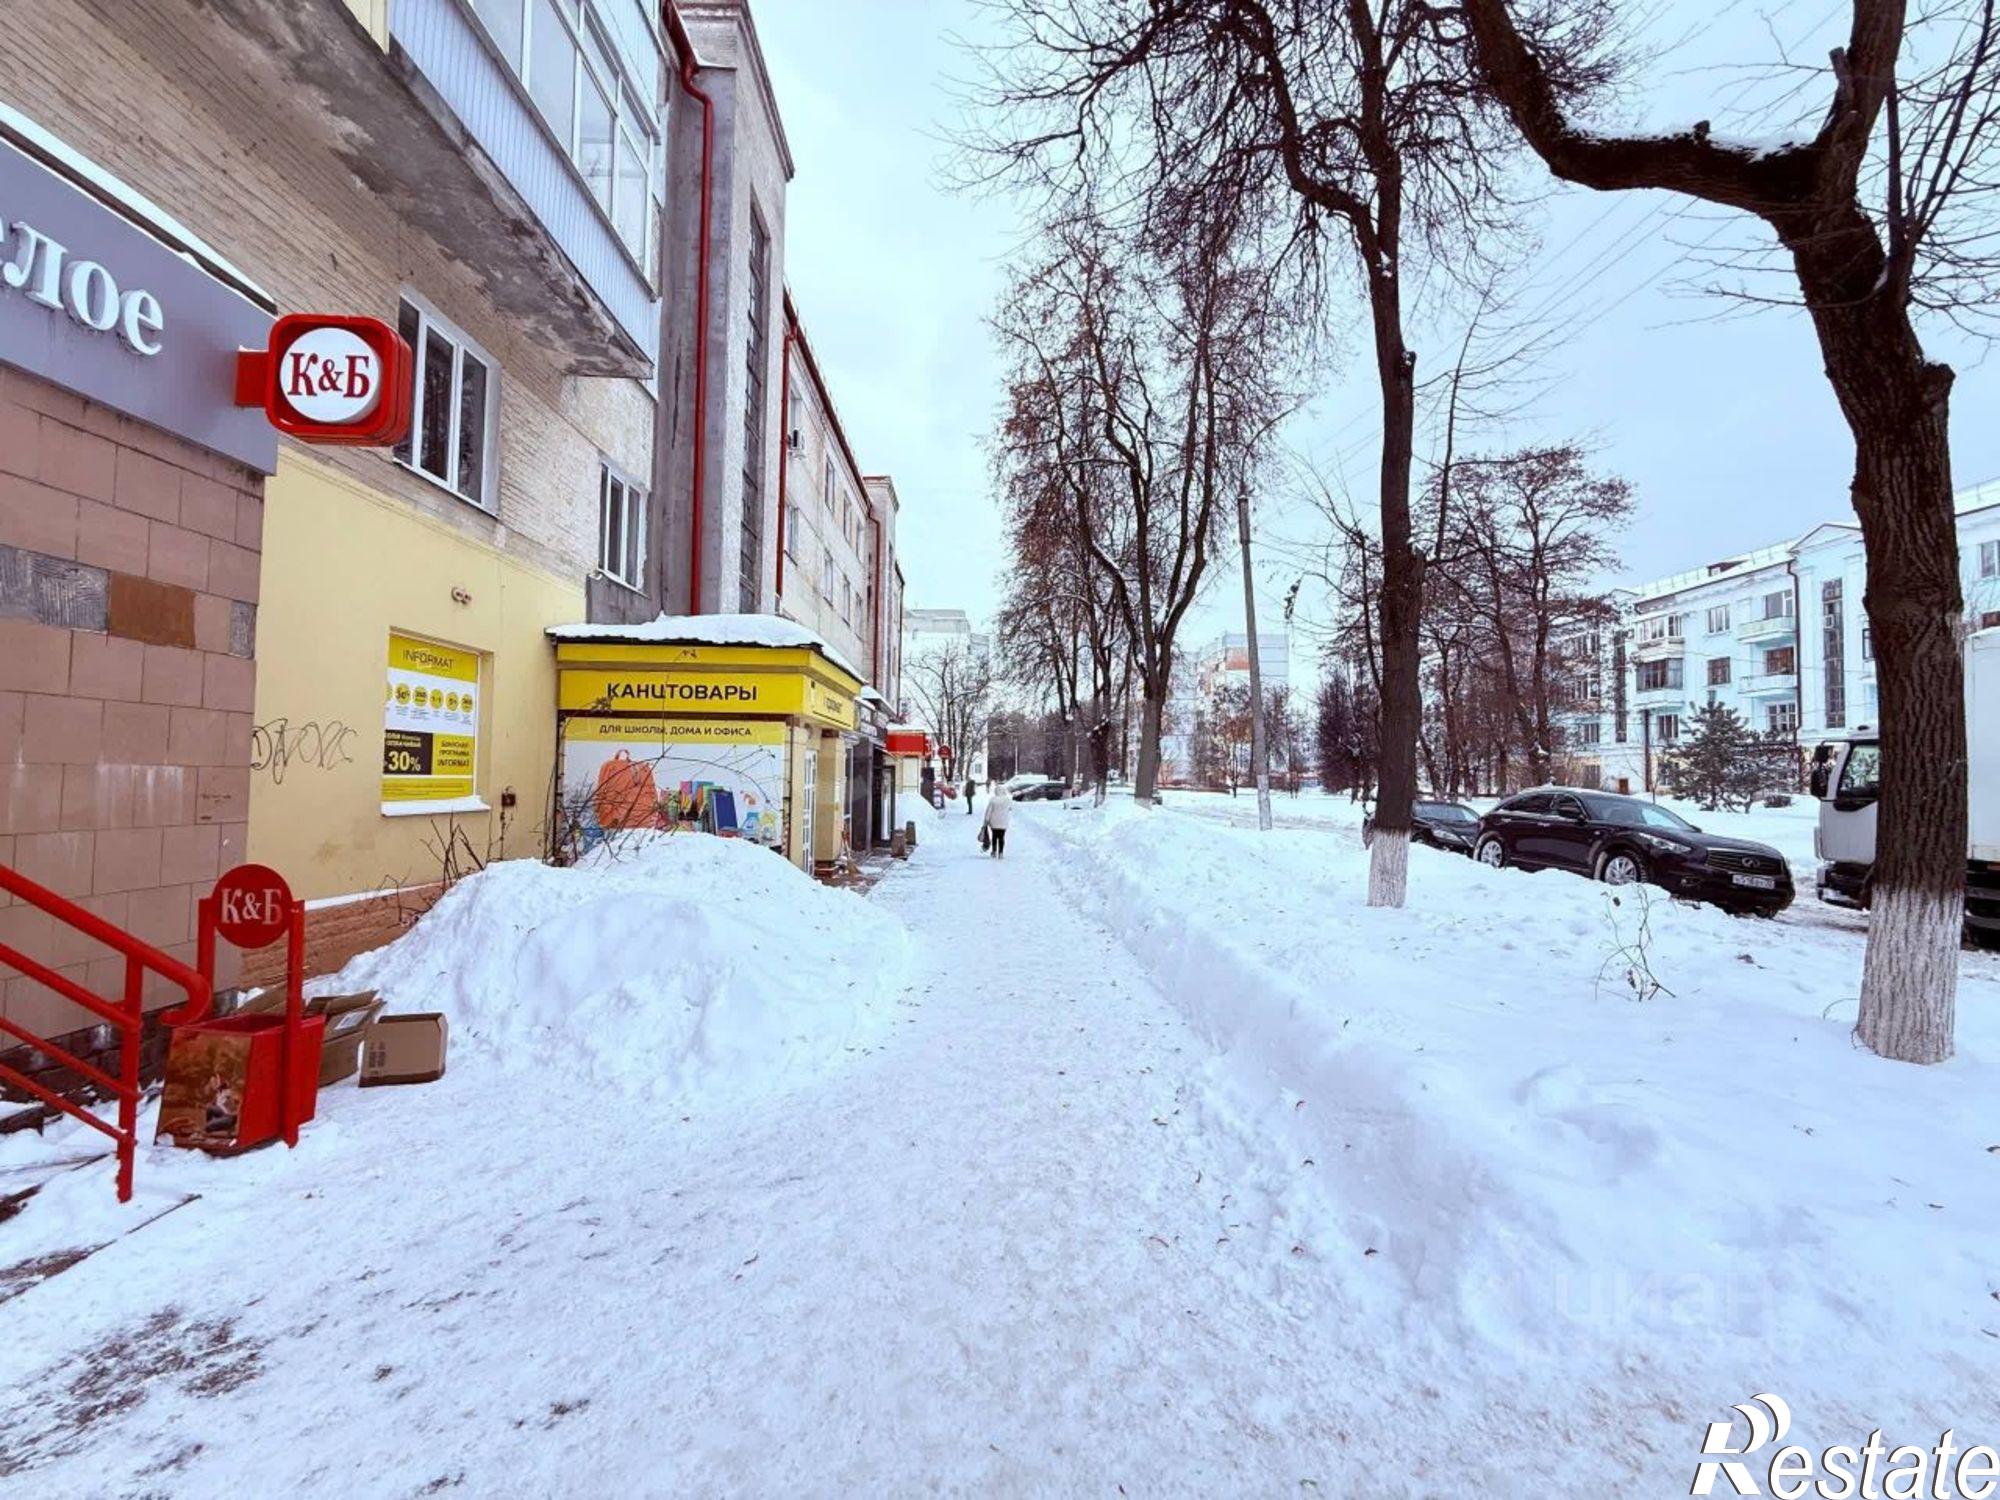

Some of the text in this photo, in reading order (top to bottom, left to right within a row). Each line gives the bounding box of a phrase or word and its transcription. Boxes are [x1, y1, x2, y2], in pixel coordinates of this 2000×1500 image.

[0, 210, 164, 357] лое
[287, 351, 371, 399] К&Б
[403, 649, 454, 669] INFORMAT
[607, 683, 757, 700] КАНЦТОВАРЫ
[600, 725, 622, 734] ДЛЯ
[670, 727, 701, 736] ДОМА
[704, 727, 712, 735] И
[714, 727, 752, 737] ОФИСА
[388, 751, 421, 771] 30%
[221, 888, 284, 926] К&Б
